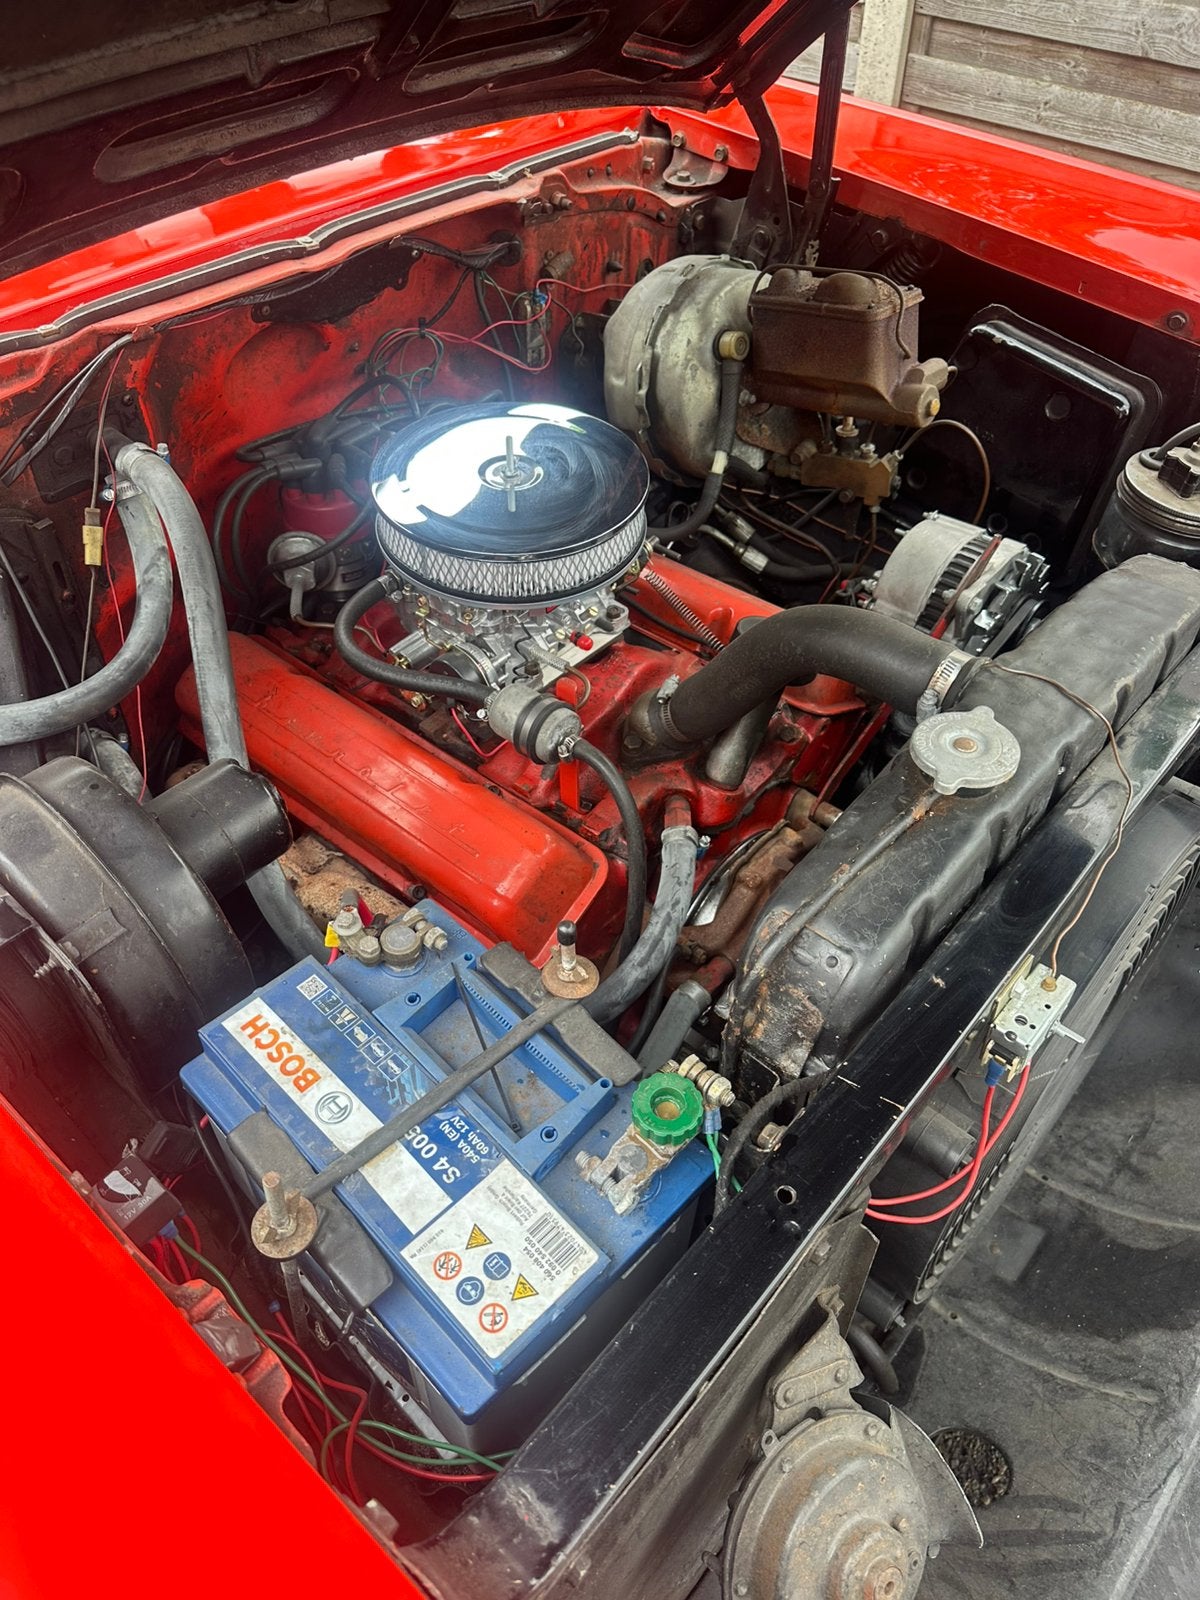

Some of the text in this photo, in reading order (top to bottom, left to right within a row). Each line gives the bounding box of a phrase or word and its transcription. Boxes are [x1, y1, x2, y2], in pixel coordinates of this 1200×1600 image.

[240, 1014, 321, 1093] BOSCH
[404, 1125, 461, 1184] S4 005
[439, 1120, 480, 1164] 540A (EN)
[449, 1115, 489, 1155] 60Ah 12V
